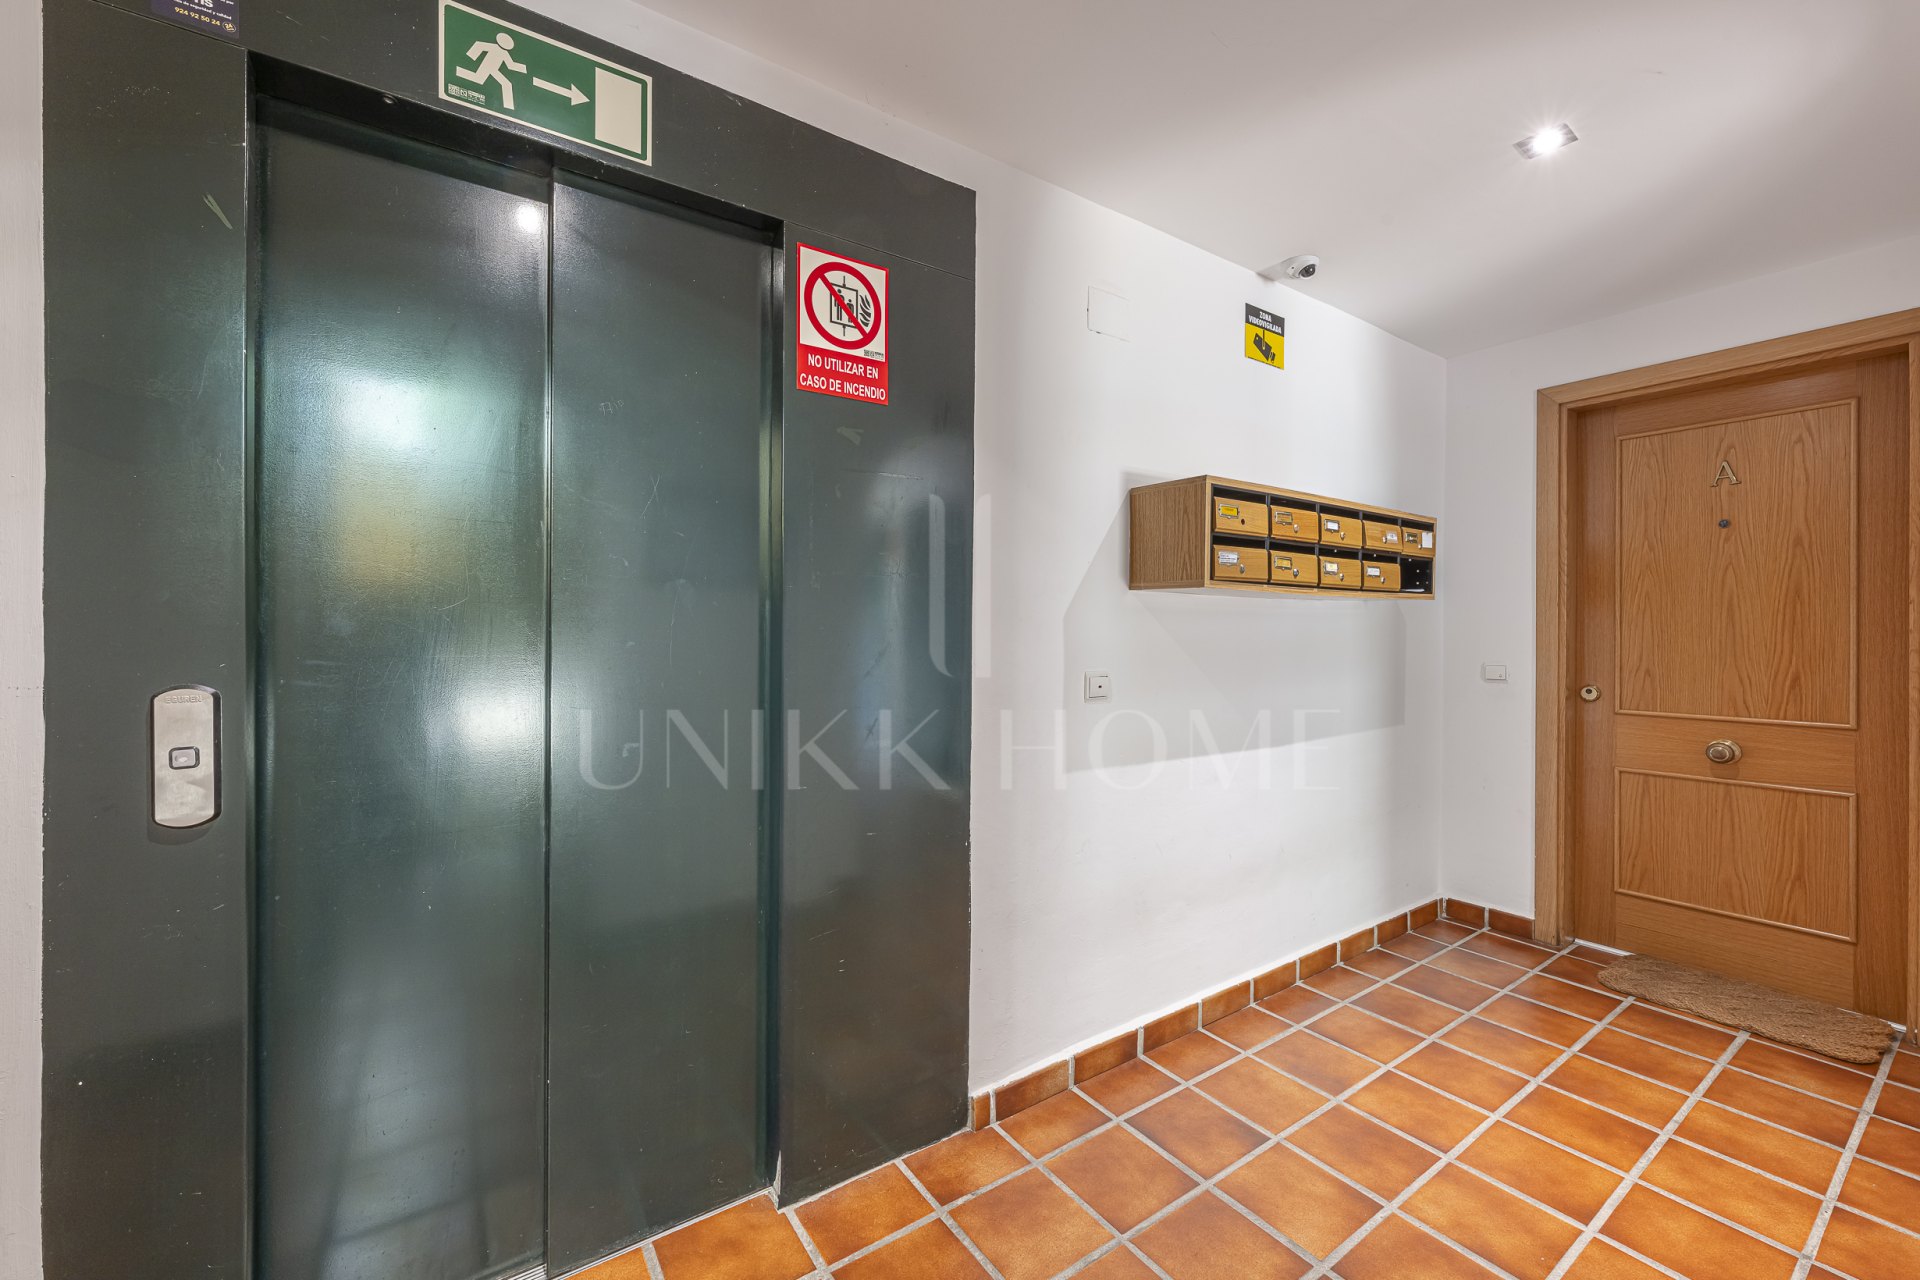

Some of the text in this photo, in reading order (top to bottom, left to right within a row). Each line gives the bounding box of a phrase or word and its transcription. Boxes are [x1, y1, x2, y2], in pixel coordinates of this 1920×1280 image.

[174, 6, 221, 26] 924 92 50 24
[1248, 314, 1282, 334] VIDEOVIGILADA
[1259, 311, 1272, 322] ZONA
[807, 353, 879, 380] NO UTILIZAR EN
[799, 373, 886, 401] CASO DE INCENDIO
[1710, 460, 1742, 487] A
